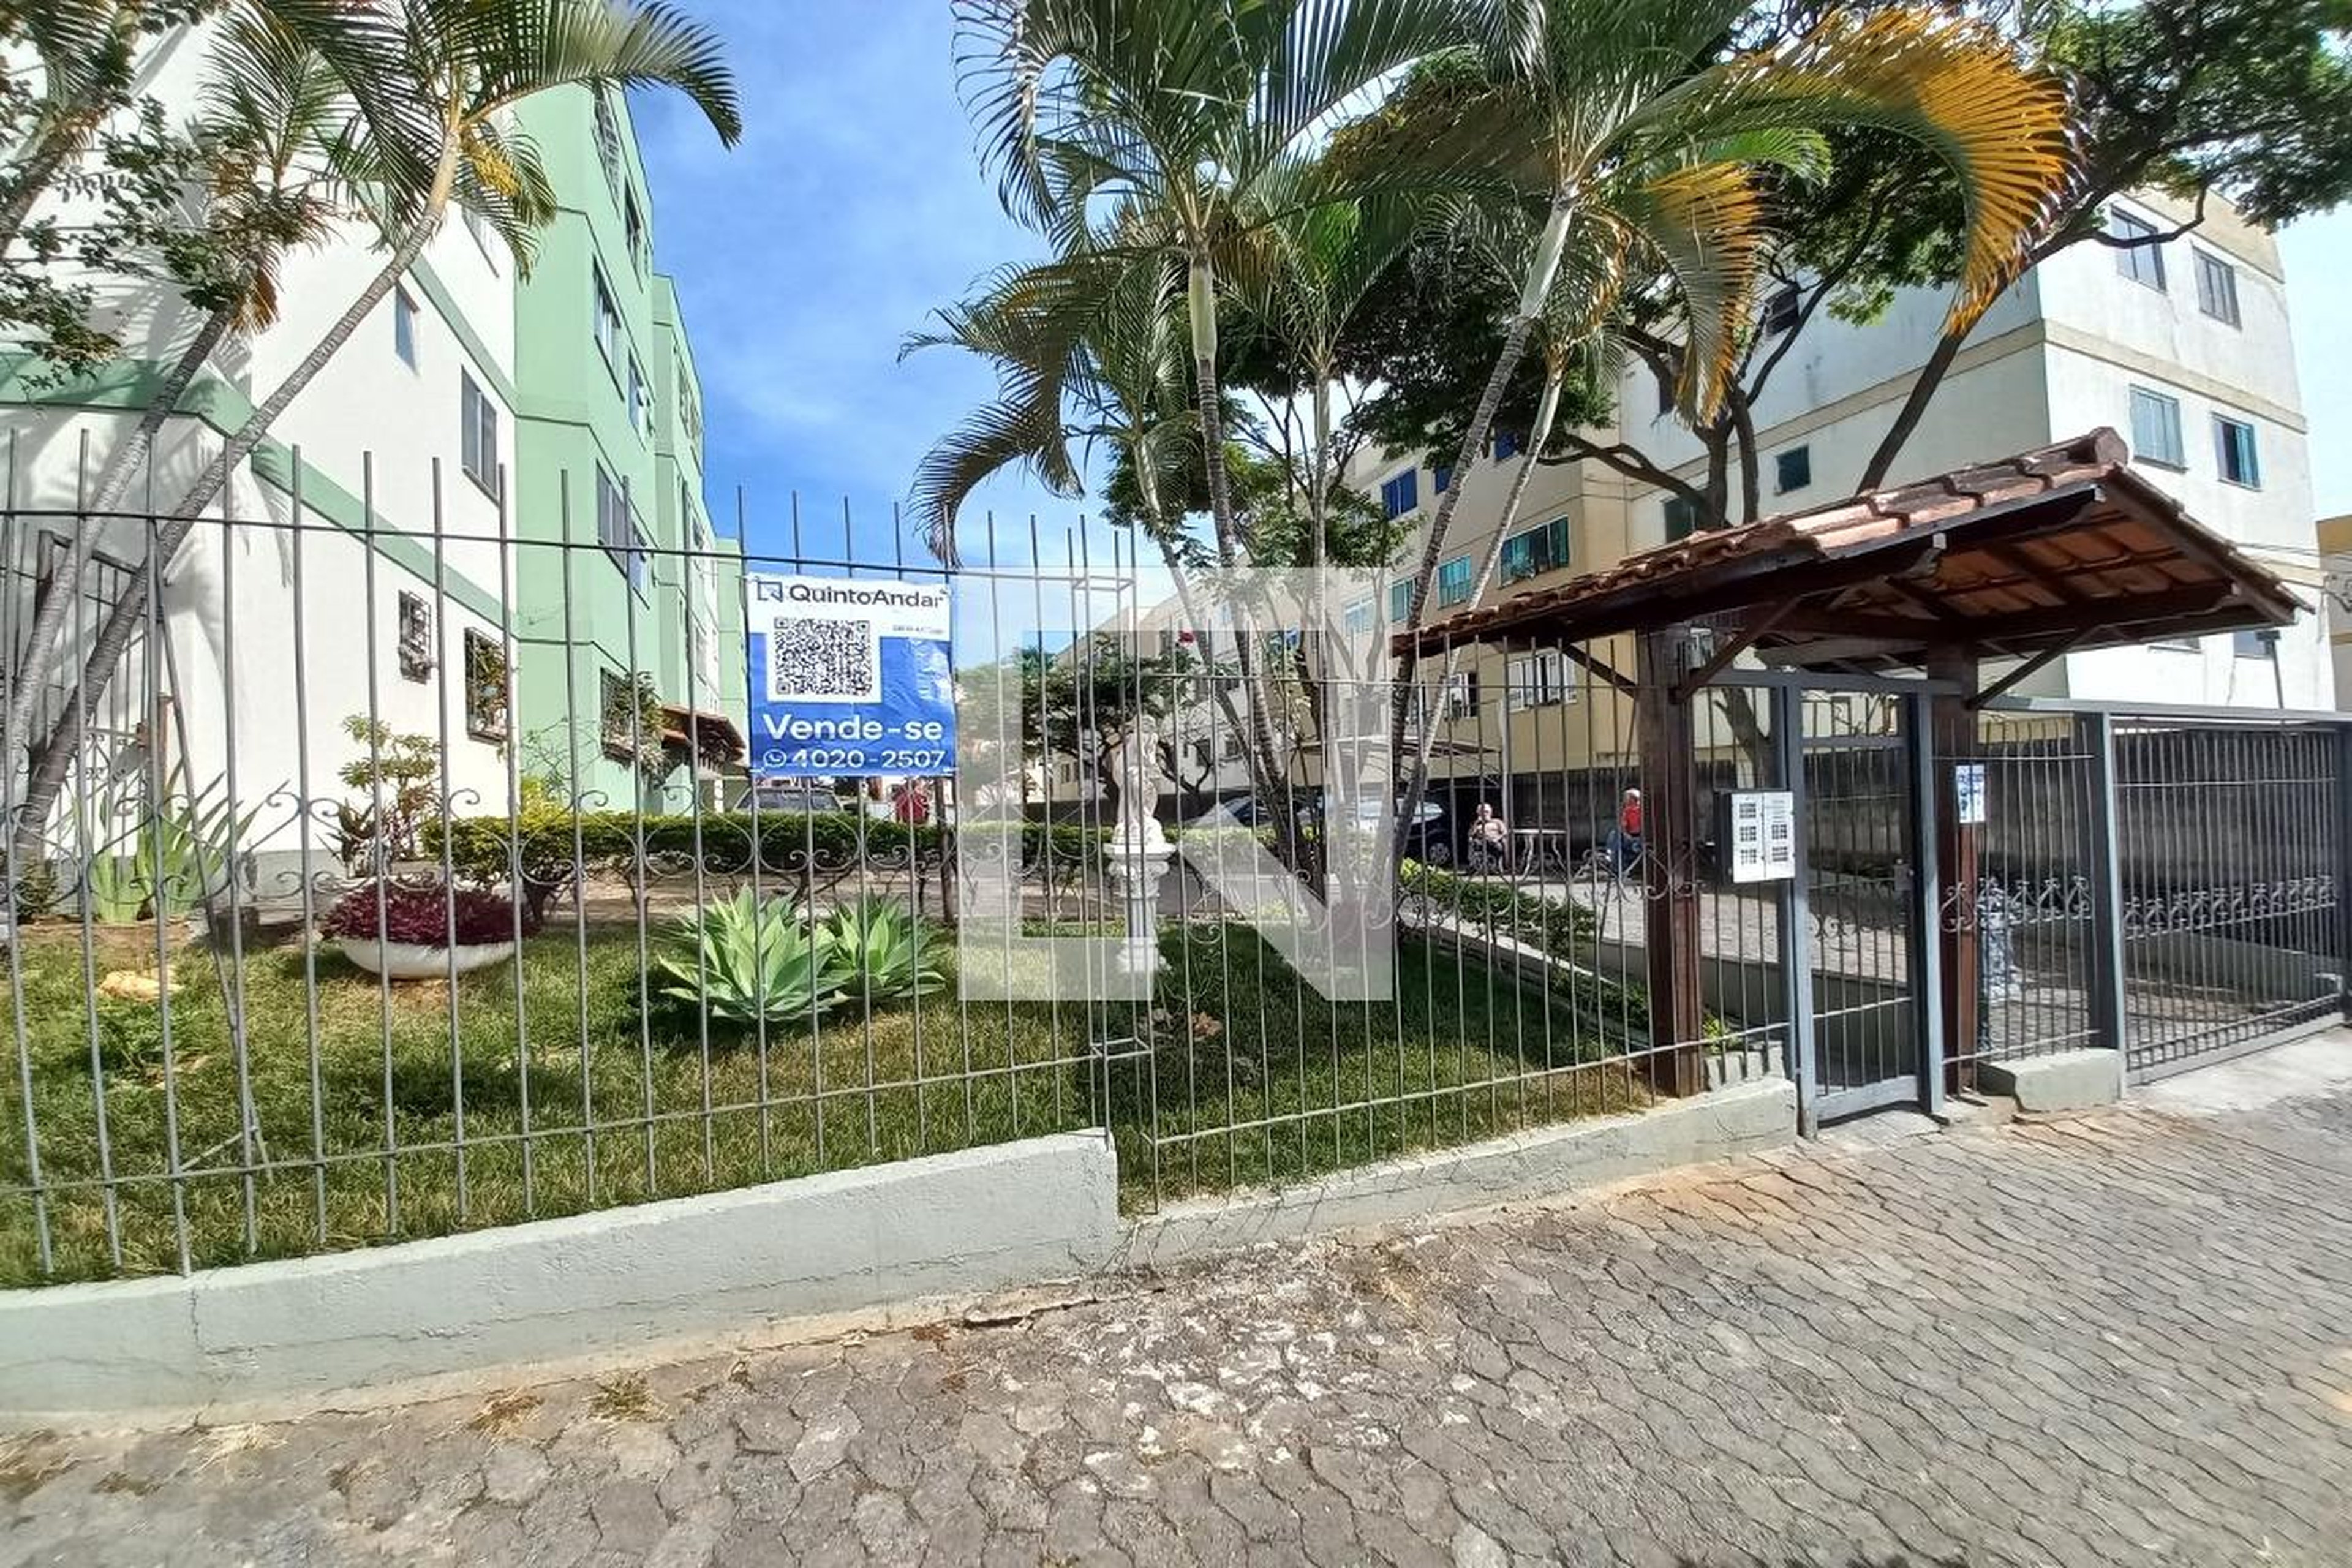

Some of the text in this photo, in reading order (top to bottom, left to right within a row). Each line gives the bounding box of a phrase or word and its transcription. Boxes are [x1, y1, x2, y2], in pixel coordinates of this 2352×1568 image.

[789, 584, 943, 608] QuintoAndar
[763, 714, 943, 740] Vende-se
[792, 748, 946, 768] 4020-2507
